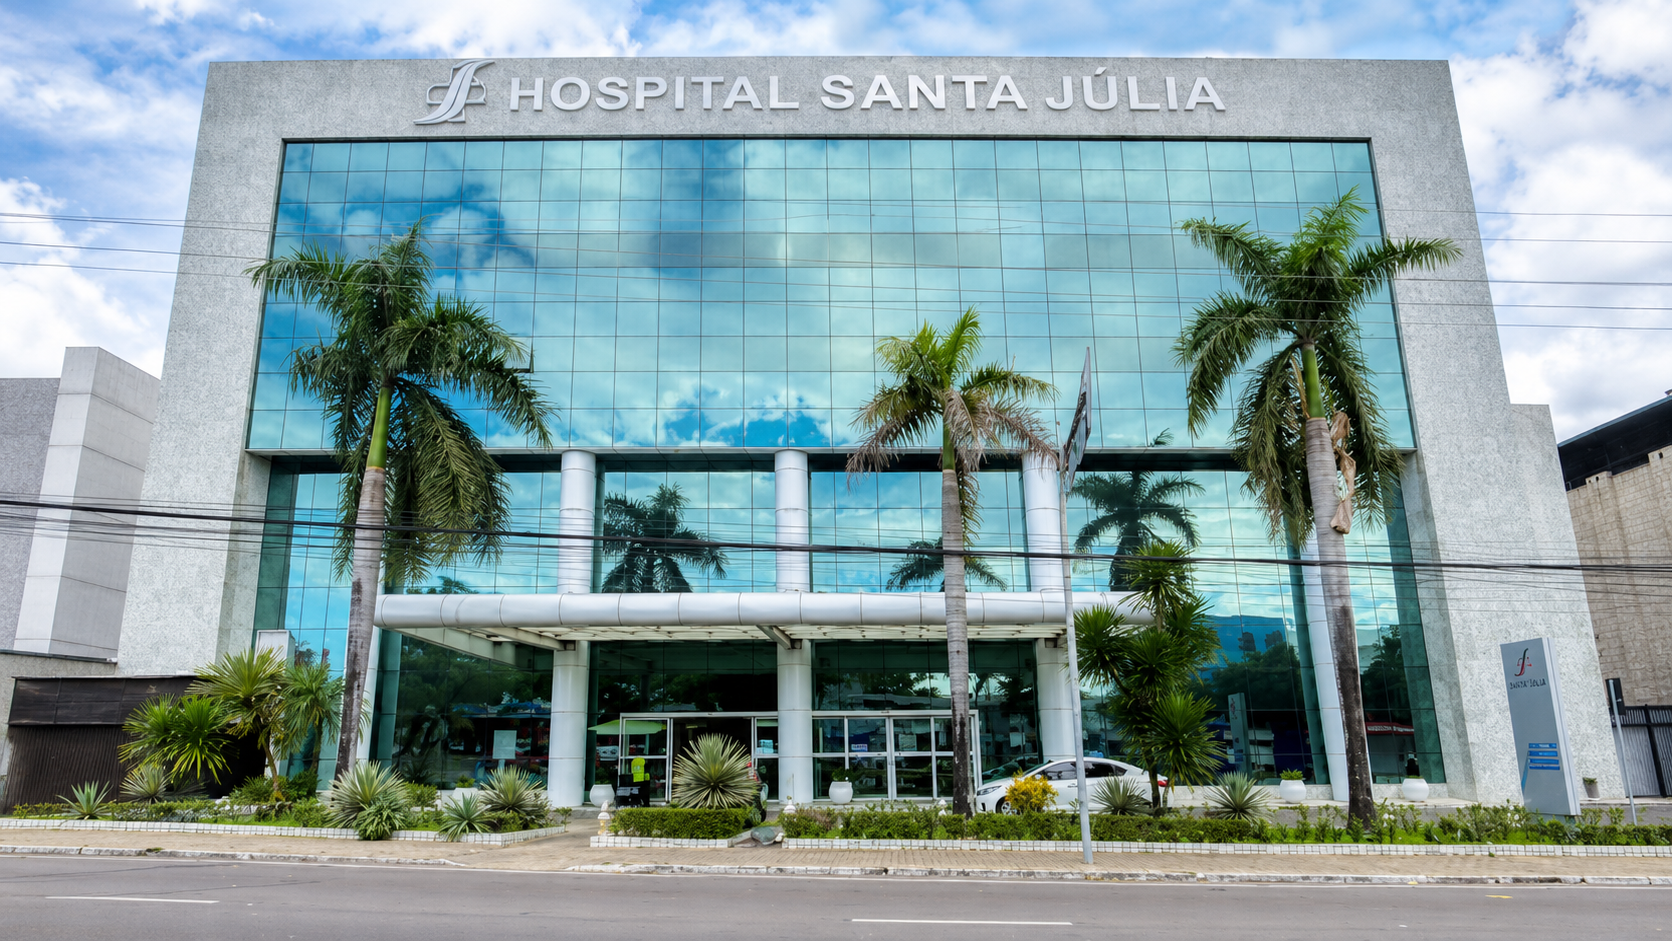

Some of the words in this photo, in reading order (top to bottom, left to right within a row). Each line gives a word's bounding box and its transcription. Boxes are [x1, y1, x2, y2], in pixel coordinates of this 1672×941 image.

[510, 76, 799, 111] HOSPITAL
[821, 74, 1028, 110] SANTA
[1045, 66, 1226, 111] JÚLIA
